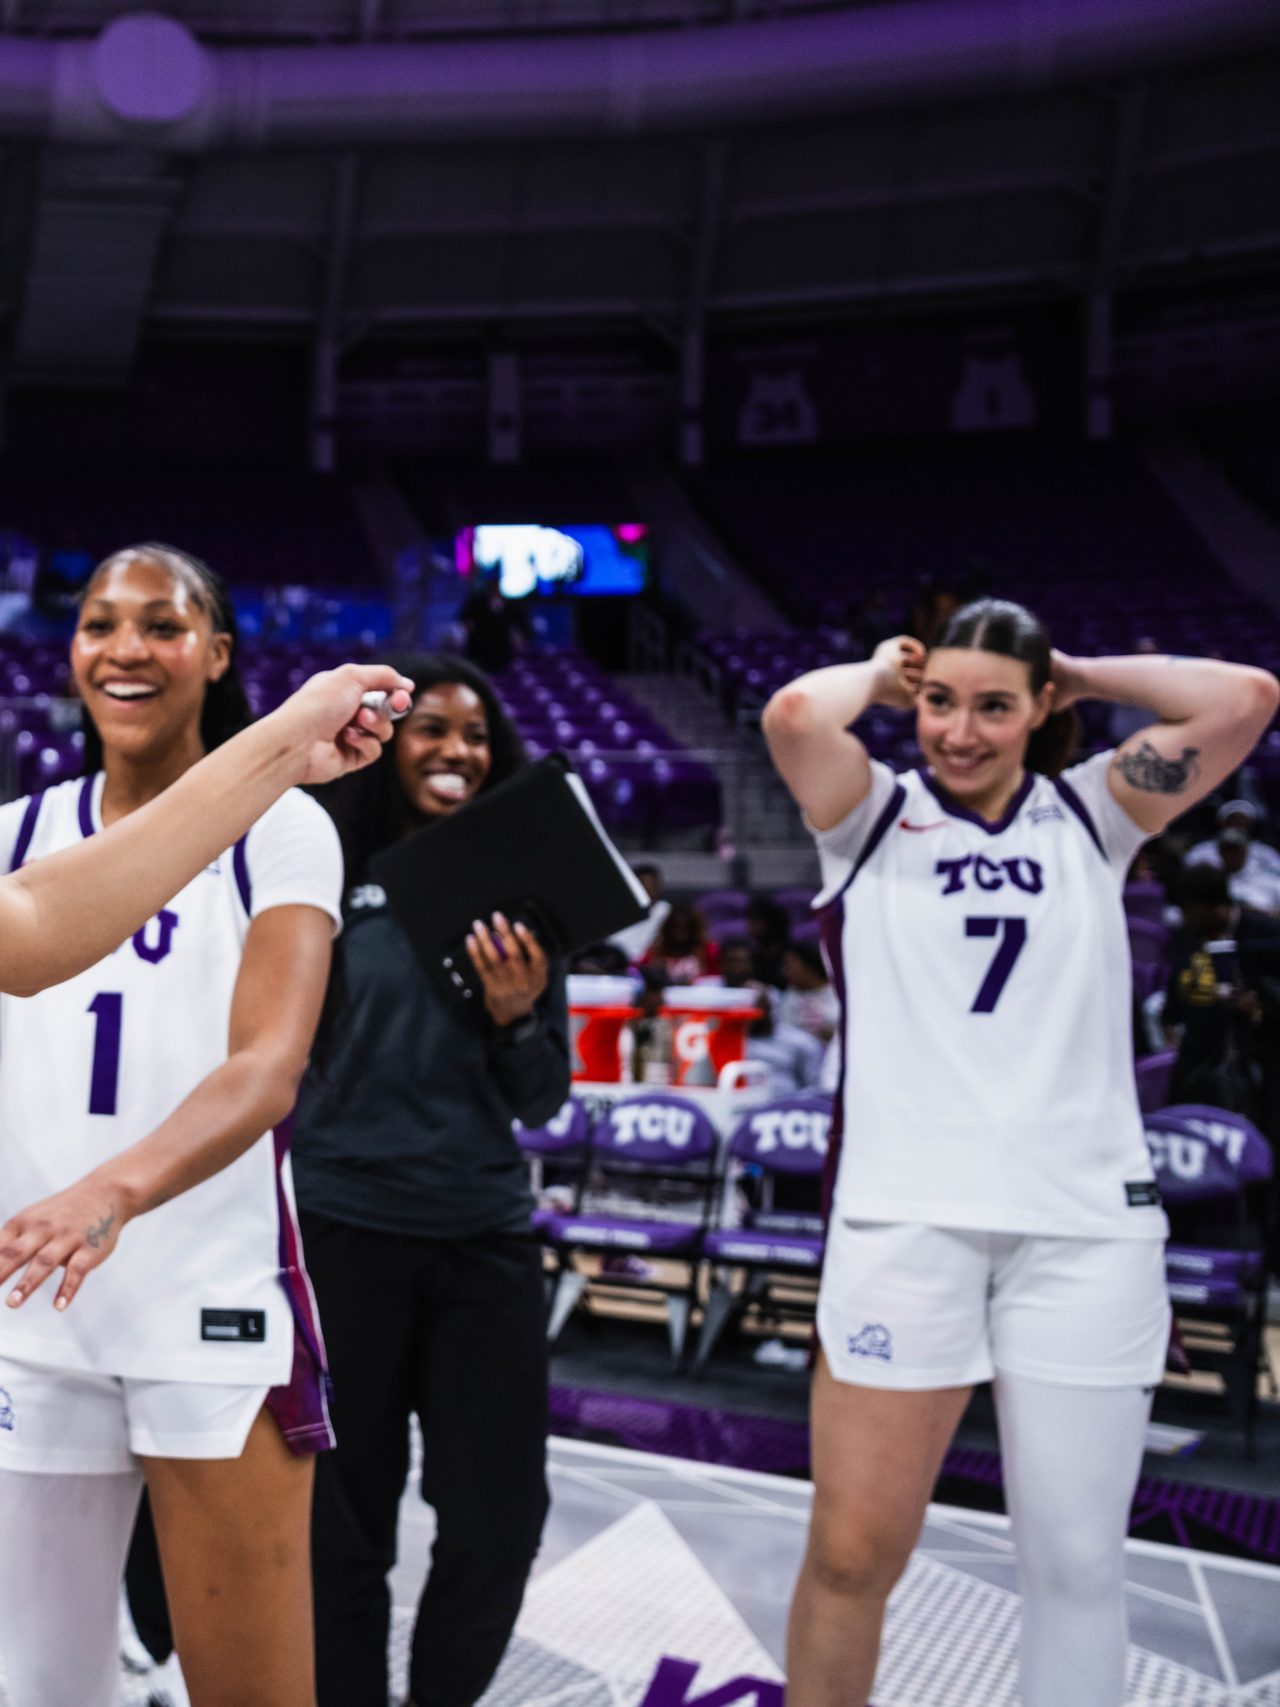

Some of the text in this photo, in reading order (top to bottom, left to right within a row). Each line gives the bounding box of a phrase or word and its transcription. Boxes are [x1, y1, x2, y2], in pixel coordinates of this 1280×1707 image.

[935, 853, 1045, 896] TCU
[964, 915, 1028, 1013] 7
[86, 991, 123, 1116] 1
[611, 1103, 695, 1147] TCU
